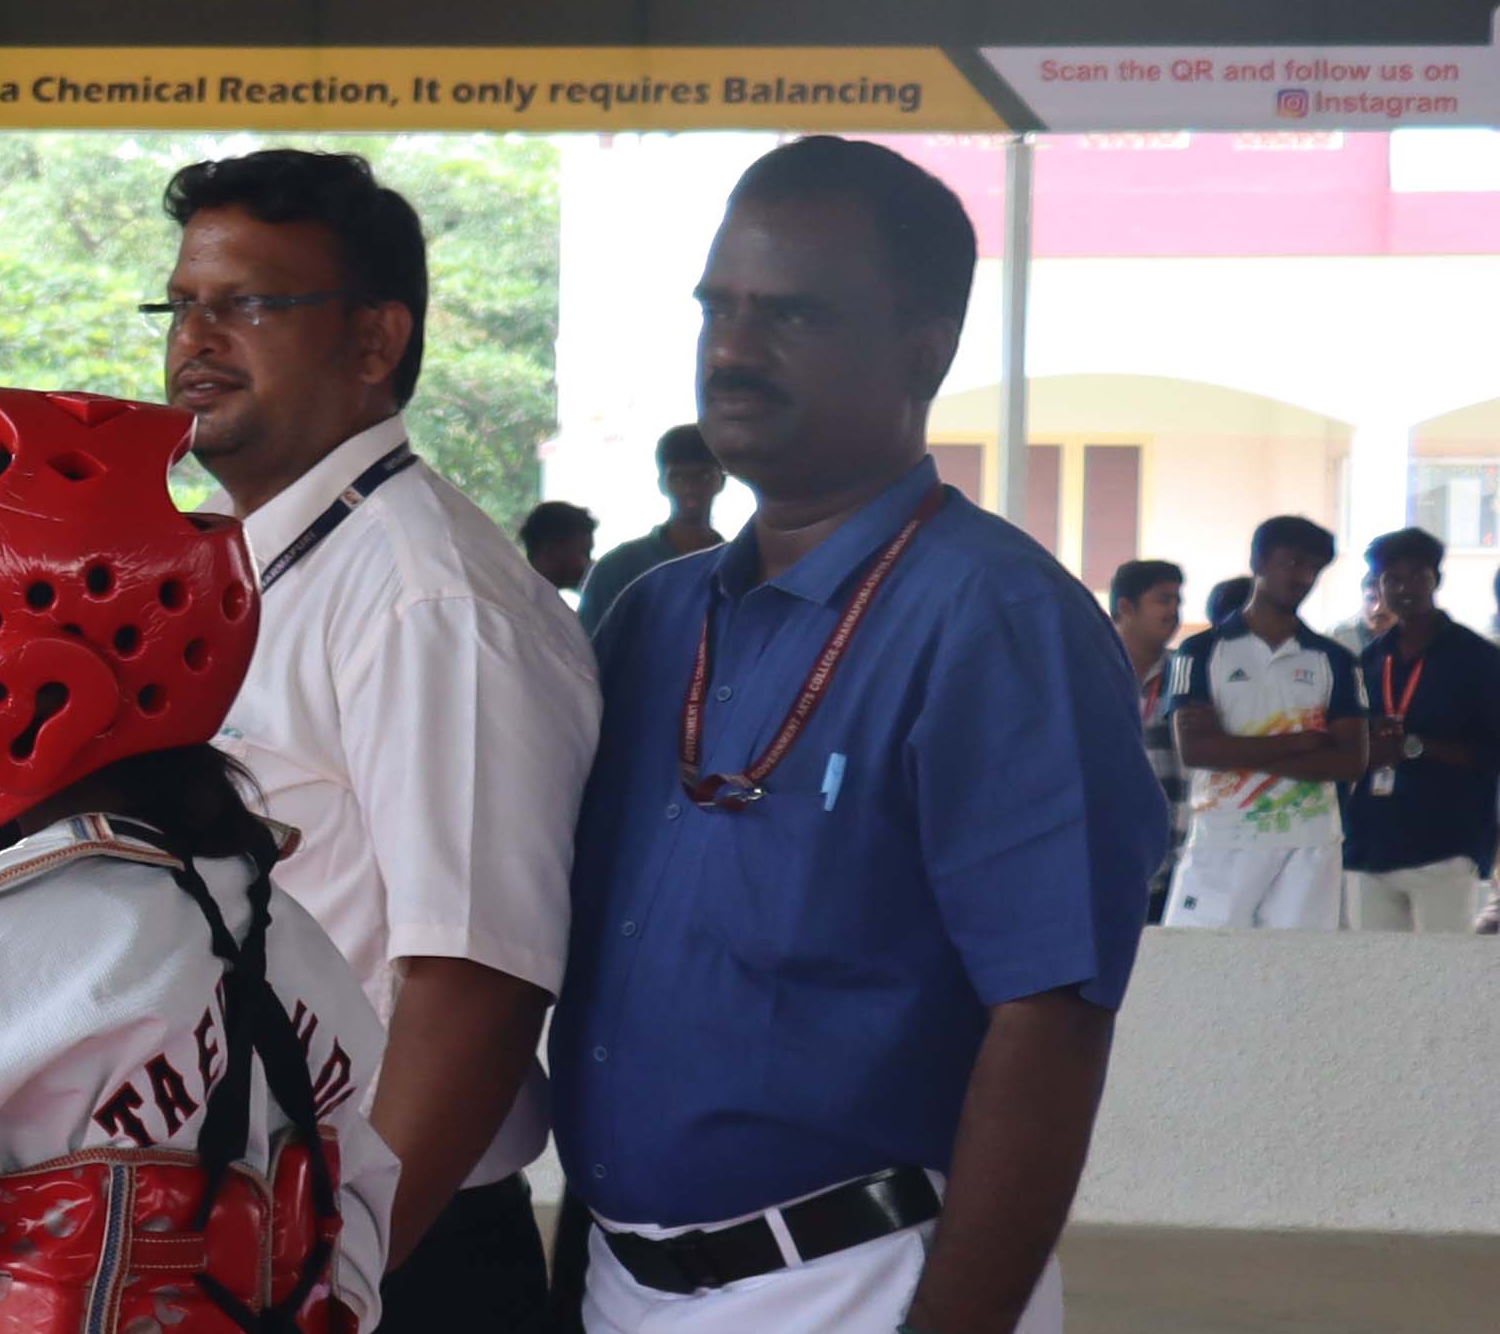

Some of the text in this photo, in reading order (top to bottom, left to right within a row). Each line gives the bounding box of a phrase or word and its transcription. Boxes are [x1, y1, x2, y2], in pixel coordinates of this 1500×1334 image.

[1041, 58, 1459, 81] Scan the QR and follow us on
[0, 81, 20, 102] a
[31, 74, 207, 103] Chemical
[218, 74, 399, 107] Reaction,
[413, 76, 441, 102] It
[452, 76, 538, 112] only
[549, 77, 710, 113] requires
[722, 76, 922, 113] Balancing
[1315, 91, 1458, 117] Instagram
